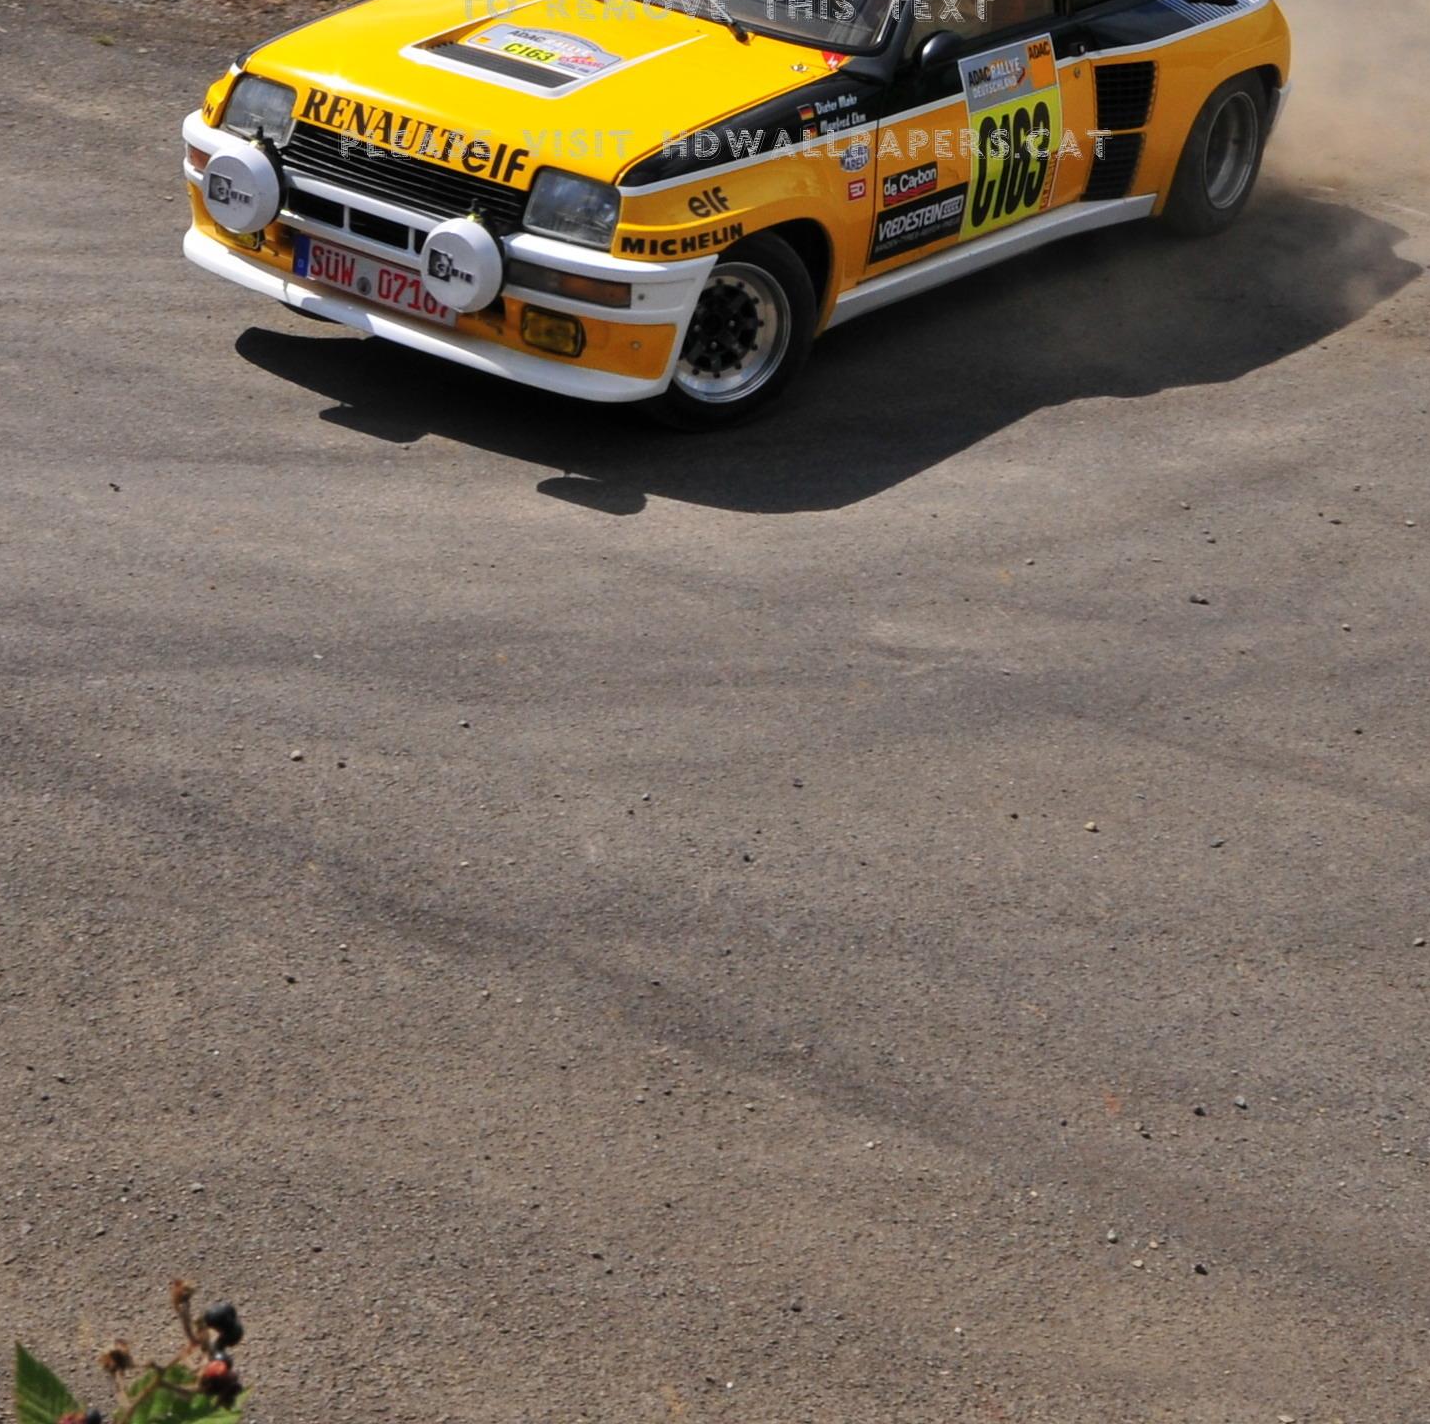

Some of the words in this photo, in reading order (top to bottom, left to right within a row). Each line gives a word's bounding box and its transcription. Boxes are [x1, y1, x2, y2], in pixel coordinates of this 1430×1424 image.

[504, 43, 556, 62] C163
[1027, 40, 1051, 61] ADAC
[298, 87, 466, 164] RENAULT
[461, 139, 530, 184] elf
[883, 178, 897, 195] de
[899, 168, 937, 192] Carbon
[971, 101, 1050, 228] C163
[688, 186, 729, 218] elf
[621, 222, 744, 256] MICHELIN
[879, 203, 943, 242] VREDESTEIN
[311, 243, 355, 286] SÜW
